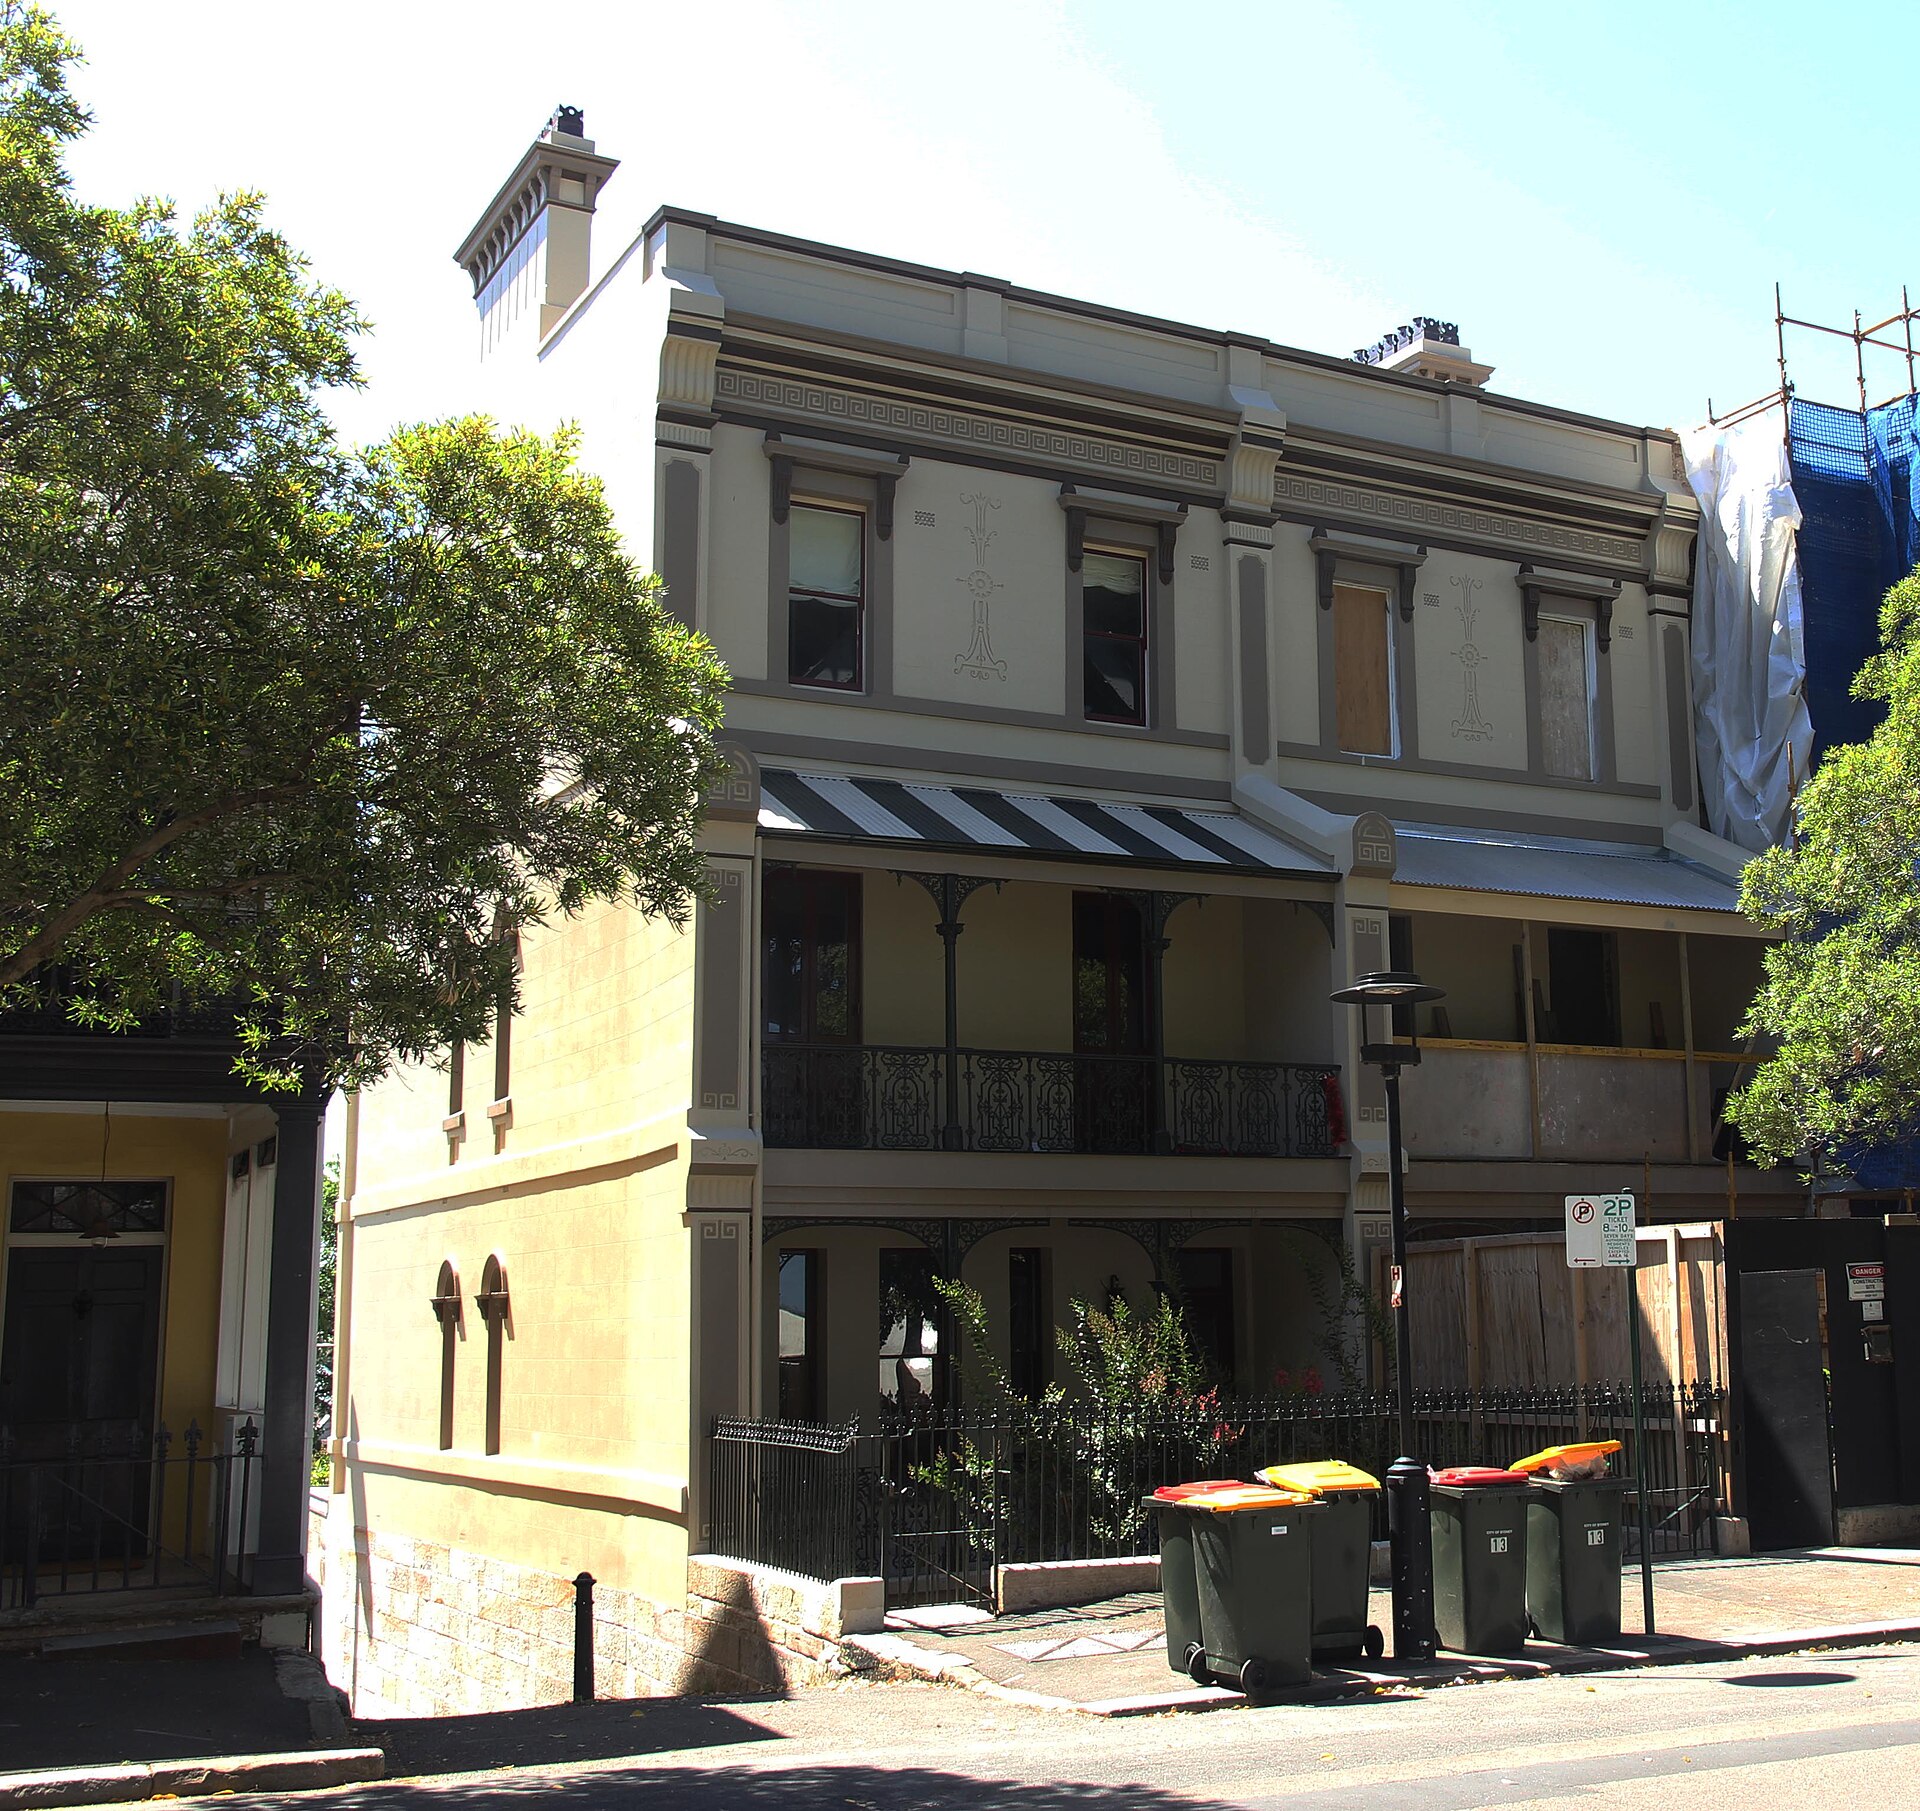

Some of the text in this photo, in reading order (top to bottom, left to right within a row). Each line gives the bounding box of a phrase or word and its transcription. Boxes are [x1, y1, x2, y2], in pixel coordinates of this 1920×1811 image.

[1603, 1199, 1631, 1216] 2P
[1392, 1267, 1400, 1280] H
[1590, 1531, 1602, 1544] 13
[1493, 1538, 1506, 1551] 13
